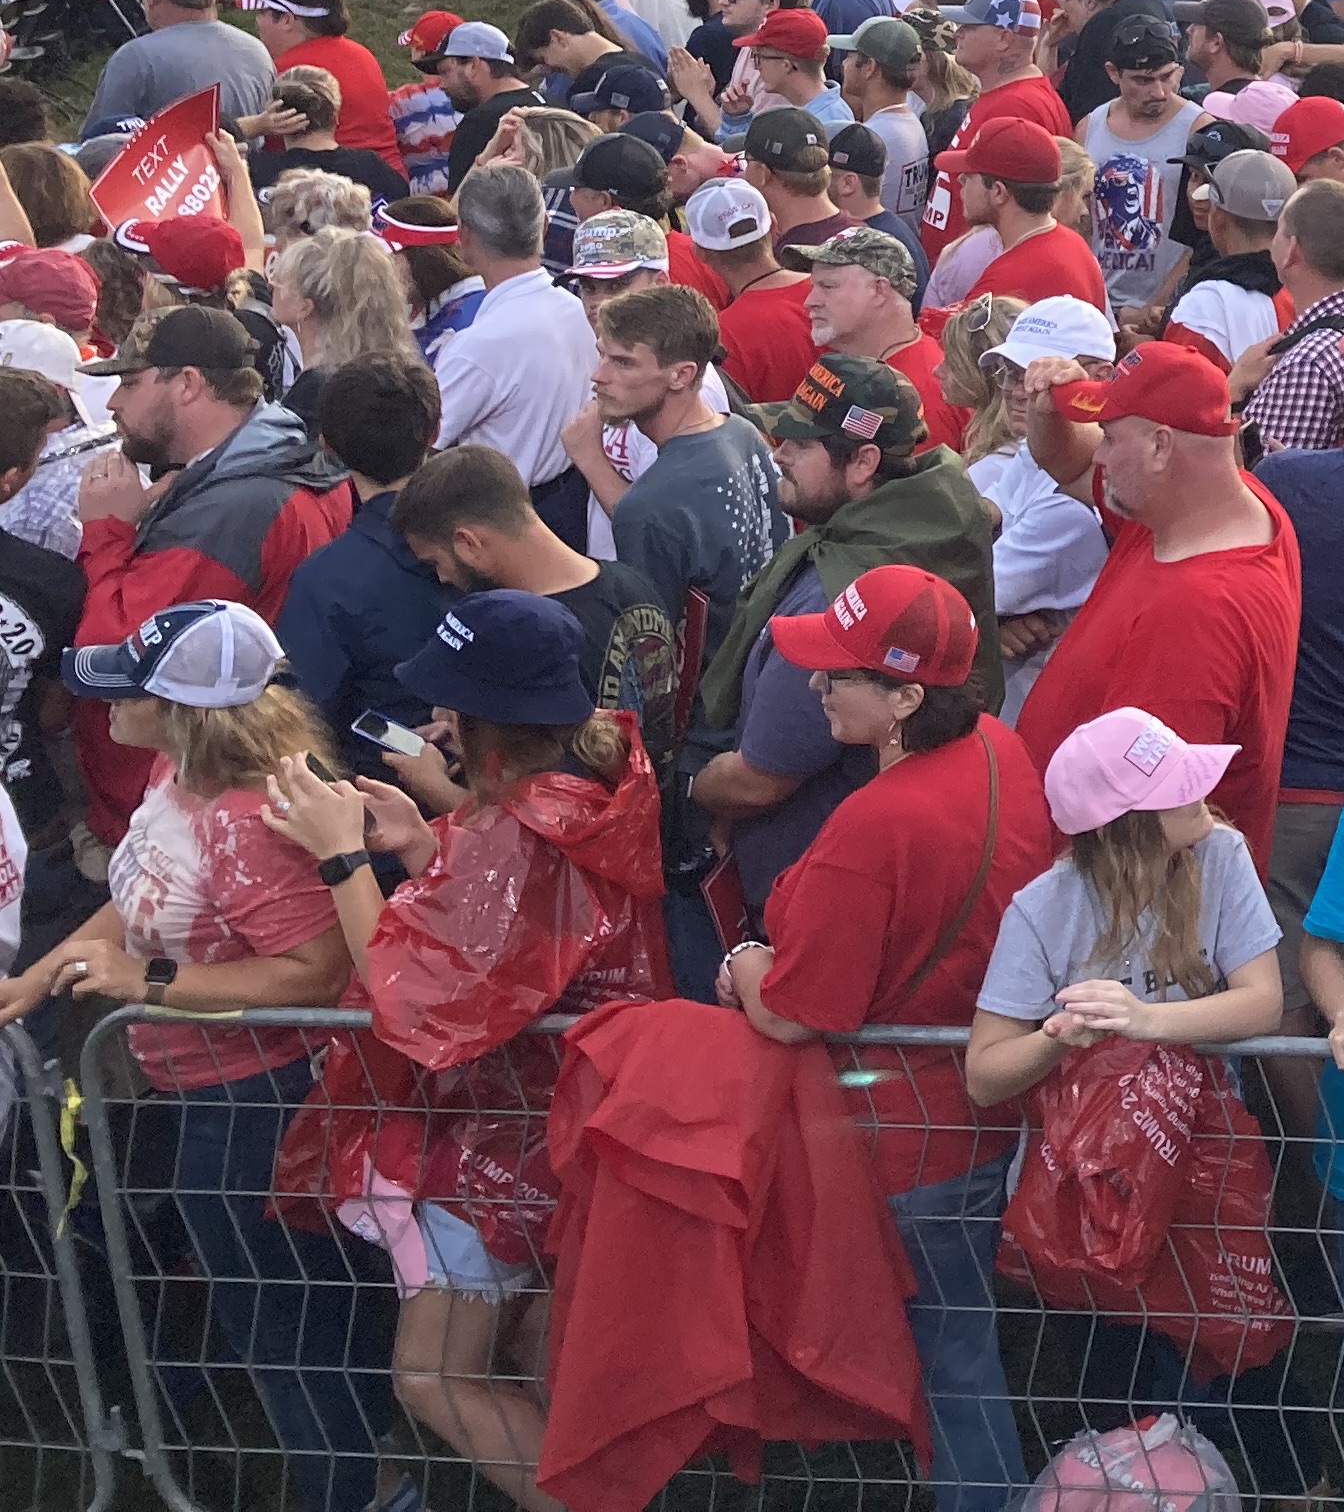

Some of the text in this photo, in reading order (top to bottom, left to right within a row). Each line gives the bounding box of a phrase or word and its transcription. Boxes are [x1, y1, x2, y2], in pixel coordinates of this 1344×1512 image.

[116, 117, 146, 132] TRU
[130, 133, 169, 186] TEXT
[904, 168, 924, 188] TRU
[143, 155, 189, 217] RALLY
[846, 581, 868, 622] ERICA
[1130, 718, 1165, 758] WOM
[1141, 730, 1178, 767] TRU
[1132, 1106, 1182, 1167] TRUMP
[1217, 1251, 1272, 1276] TRUM
